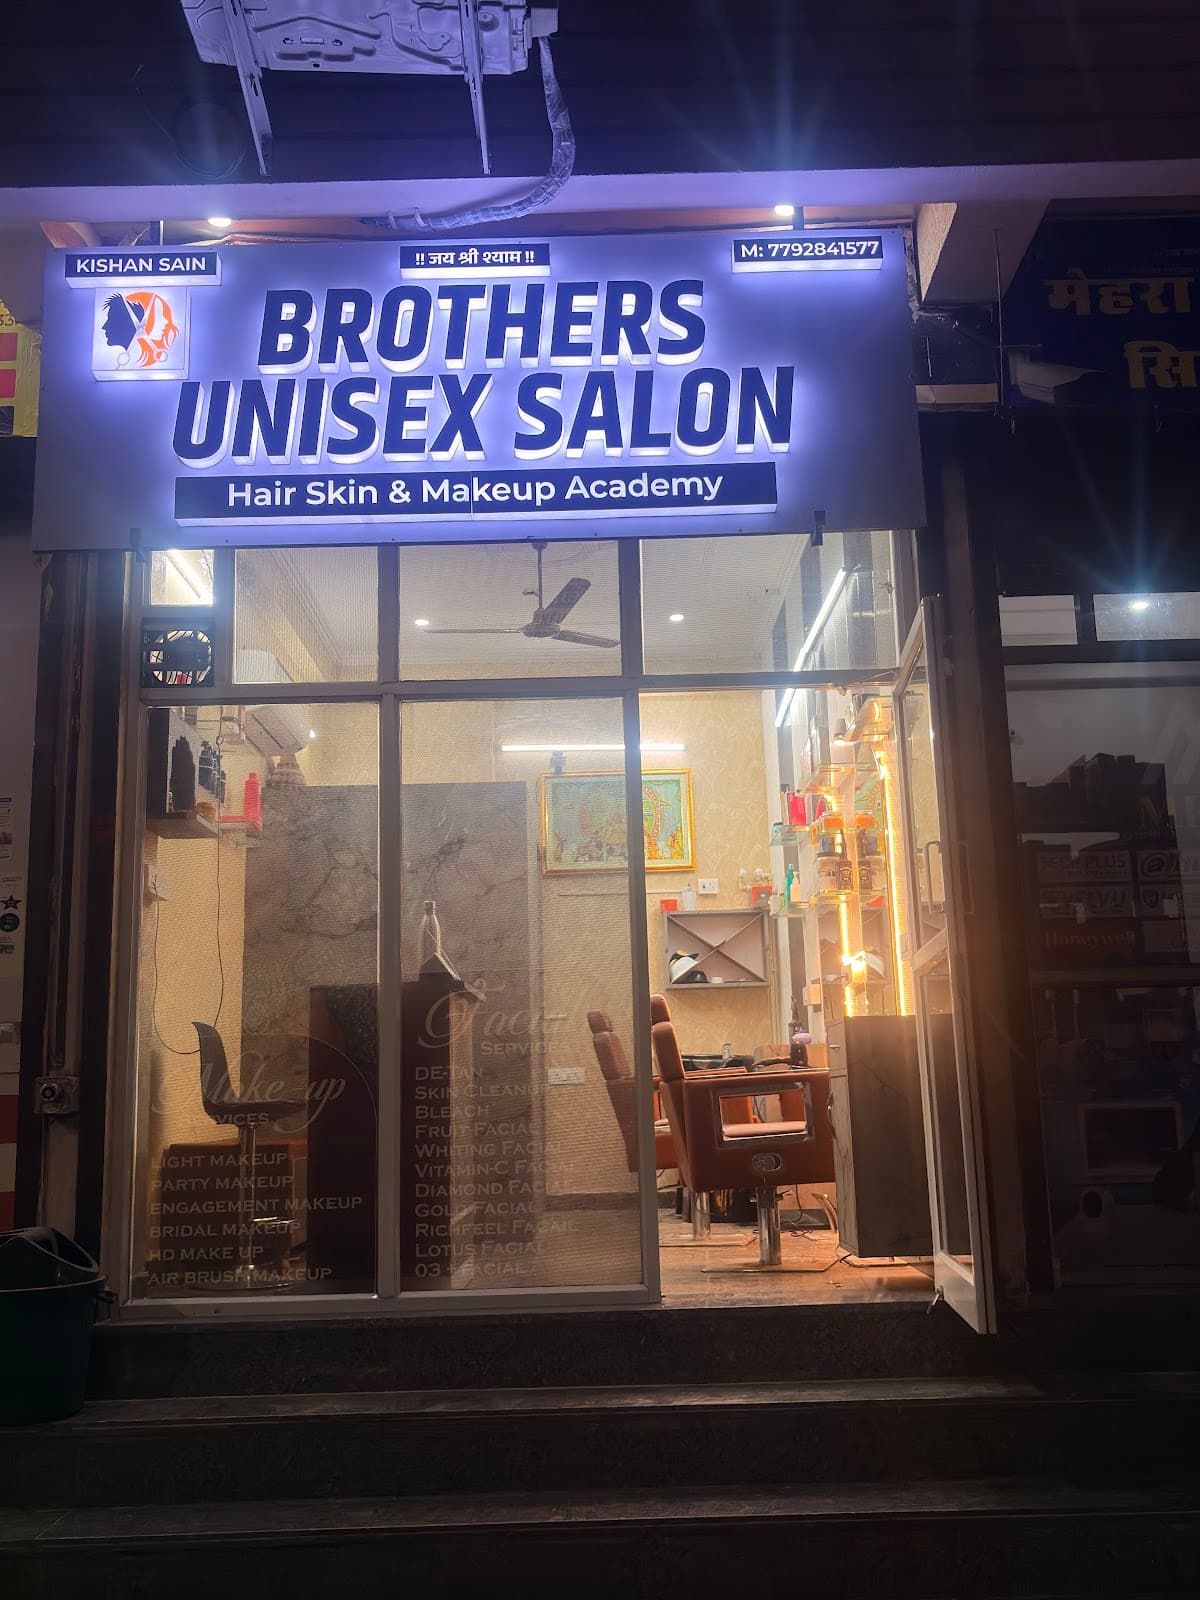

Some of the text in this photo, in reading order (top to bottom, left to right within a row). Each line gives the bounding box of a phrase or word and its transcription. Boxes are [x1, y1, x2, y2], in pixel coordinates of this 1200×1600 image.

[428, 252, 456, 265] जय
[458, 247, 479, 265] श्री
[482, 250, 522, 264] श्याम
[740, 239, 880, 259] M: 7792841577
[75, 255, 207, 274] KISHAN SAIN
[257, 279, 706, 370] BROTHERS
[171, 366, 796, 466] UNISEX SALON
[227, 472, 724, 508] Hair Skin & Makeup Academy
[414, 1085, 458, 1101] SKIN
[414, 1104, 490, 1120] BLEACH
[209, 1152, 289, 1168] MAKEUP
[149, 1175, 294, 1193] PARTY MAKEUP
[414, 1181, 503, 1199] DIAMOND
[148, 1196, 363, 1216] ENGAGEMENT MAKEUP
[472, 1200, 539, 1215] FACIAL
[148, 1220, 302, 1240] BRIDAL MAKEUP
[414, 1222, 506, 1239] RICHFEEL
[180, 1246, 233, 1261] MAKE
[237, 1245, 264, 1259] UP
[414, 1243, 475, 1259] LOTUS
[147, 1266, 333, 1286] AIR BRUSH MAKEUP
